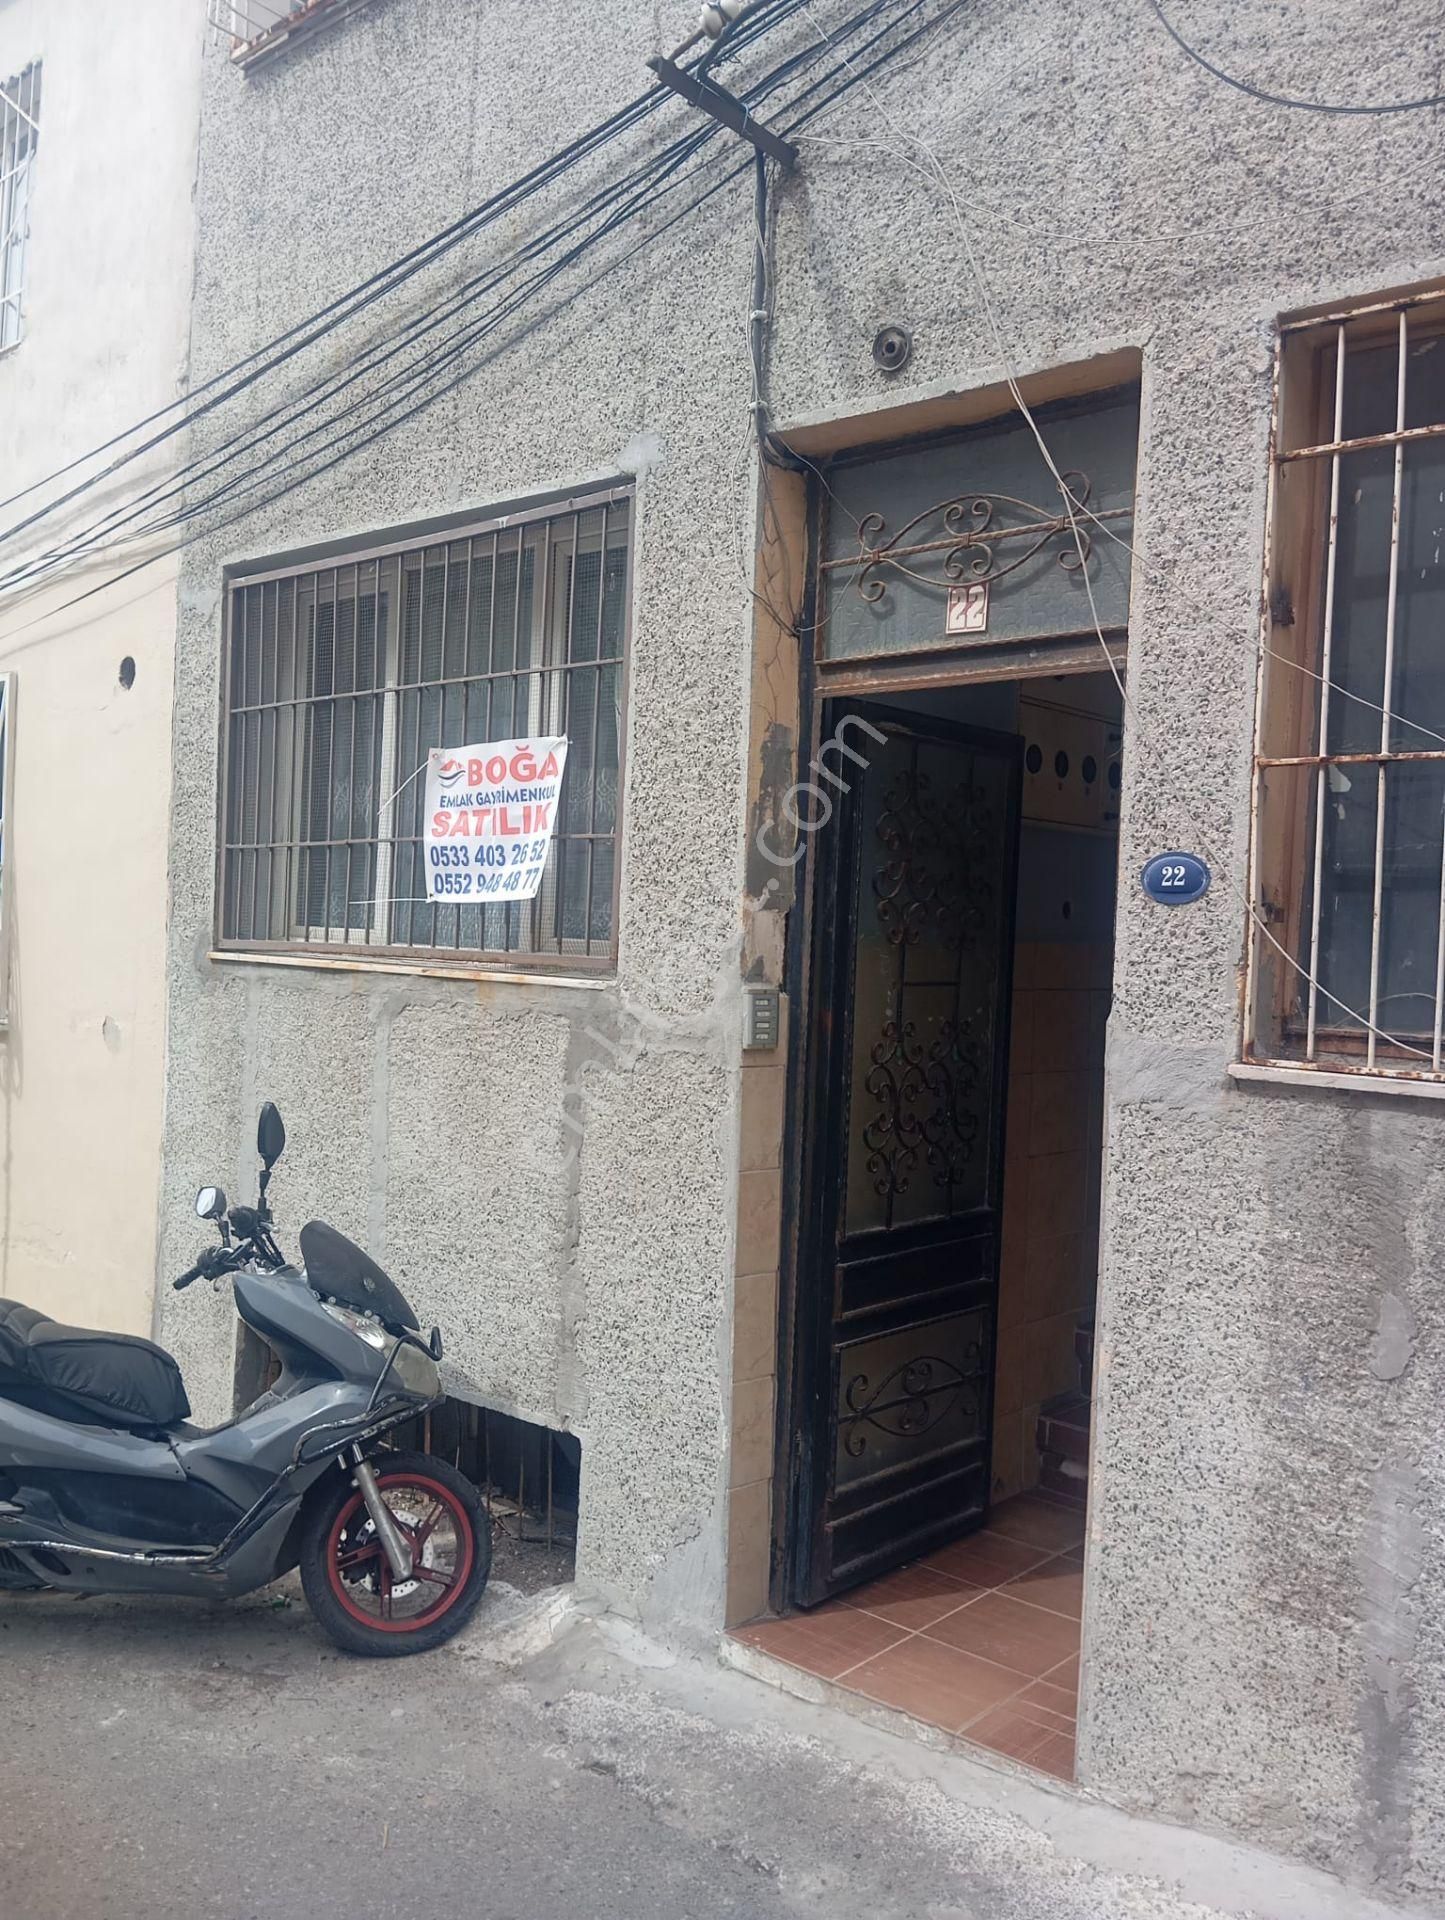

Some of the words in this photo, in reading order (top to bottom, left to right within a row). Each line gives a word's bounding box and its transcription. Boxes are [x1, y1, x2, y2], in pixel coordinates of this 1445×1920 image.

[949, 585, 985, 629] 22
[467, 744, 559, 787] BOĞA
[439, 793, 474, 809] EMLAK
[475, 784, 556, 807] GAYRİMENKUL
[431, 801, 554, 838] SATILIK
[430, 844, 470, 867] 0533
[474, 843, 506, 867] 403
[511, 842, 528, 866] 26
[529, 838, 546, 862] 52
[434, 872, 473, 895] 0552
[475, 872, 501, 894] 948
[501, 867, 521, 892] 48
[522, 867, 540, 891] 77
[1161, 865, 1186, 887] 22
